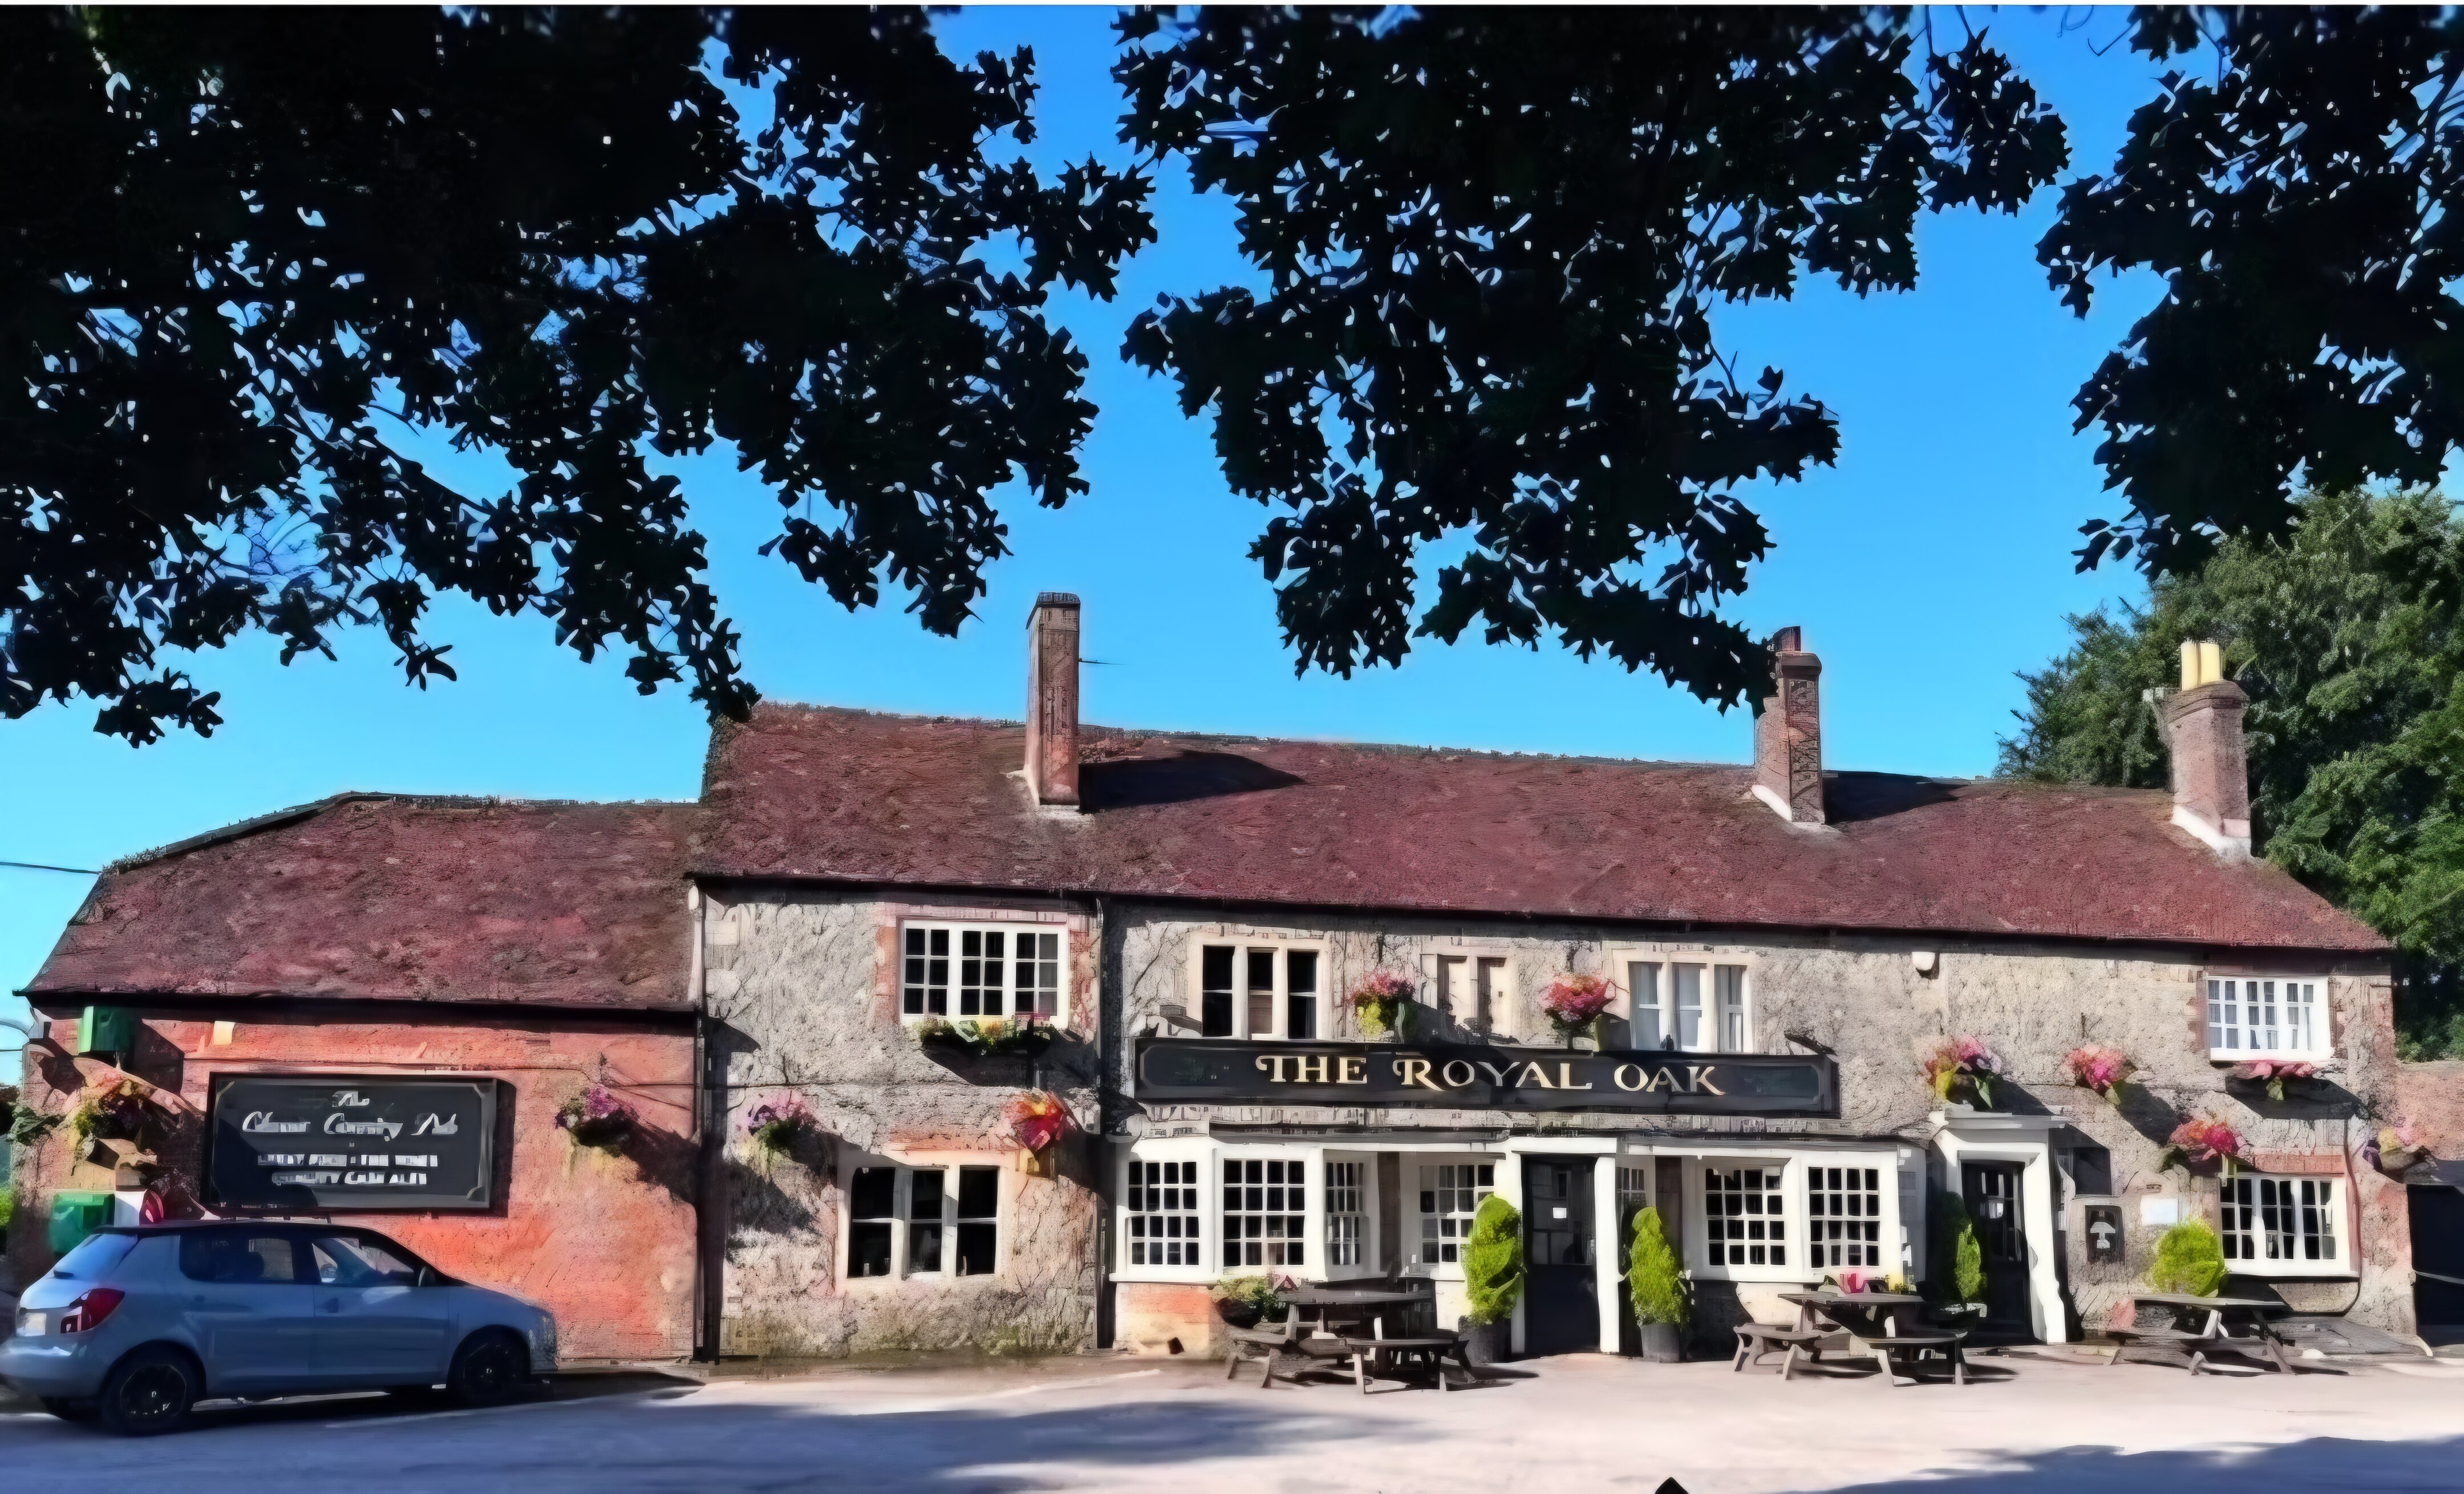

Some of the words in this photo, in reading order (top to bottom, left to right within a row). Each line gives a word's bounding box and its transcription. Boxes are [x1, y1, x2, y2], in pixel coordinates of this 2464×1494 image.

[1255, 1055, 1367, 1084] THE
[1392, 1059, 1593, 1092] ROYAL
[1614, 1063, 1725, 1096] OAK
